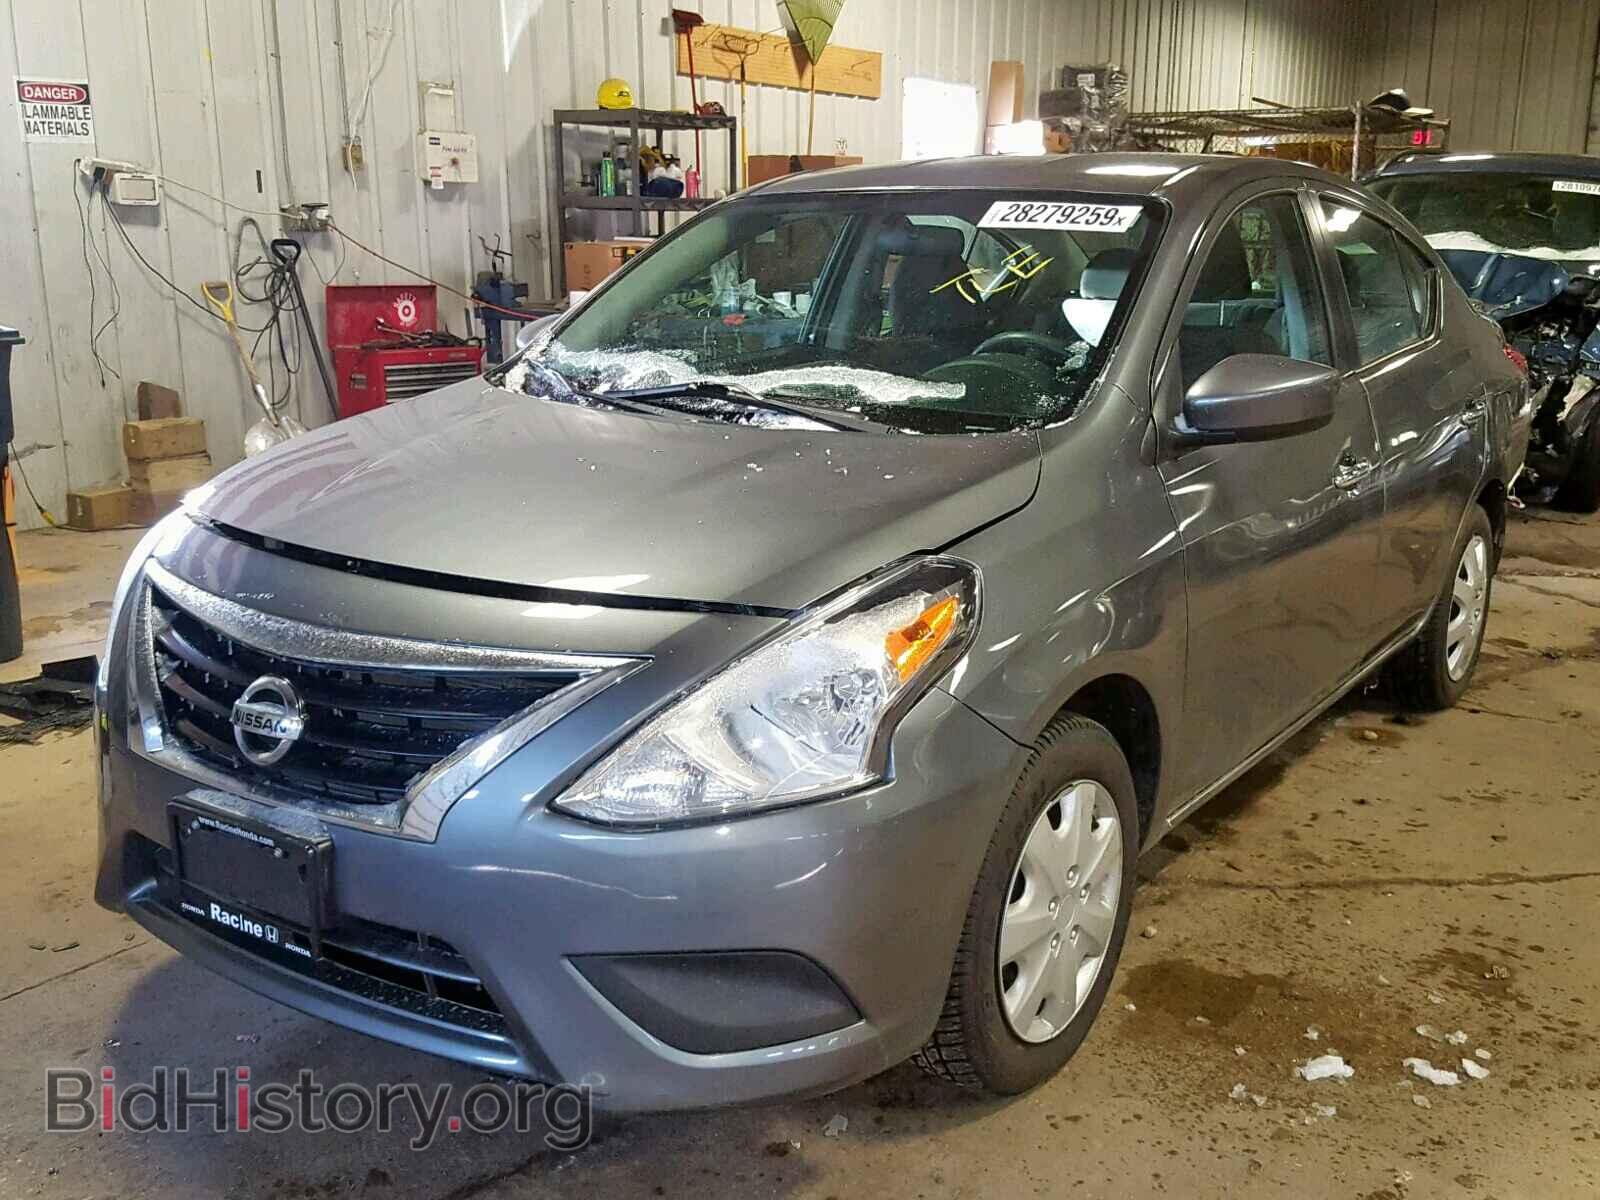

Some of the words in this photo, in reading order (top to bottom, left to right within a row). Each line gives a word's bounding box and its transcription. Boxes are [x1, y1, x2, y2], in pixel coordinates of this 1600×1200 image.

[23, 86, 78, 100] DANGER
[233, 708, 287, 734] NISSAN
[181, 902, 206, 916] HONDA
[210, 903, 263, 938] Racine
[285, 942, 312, 958] HONDA
